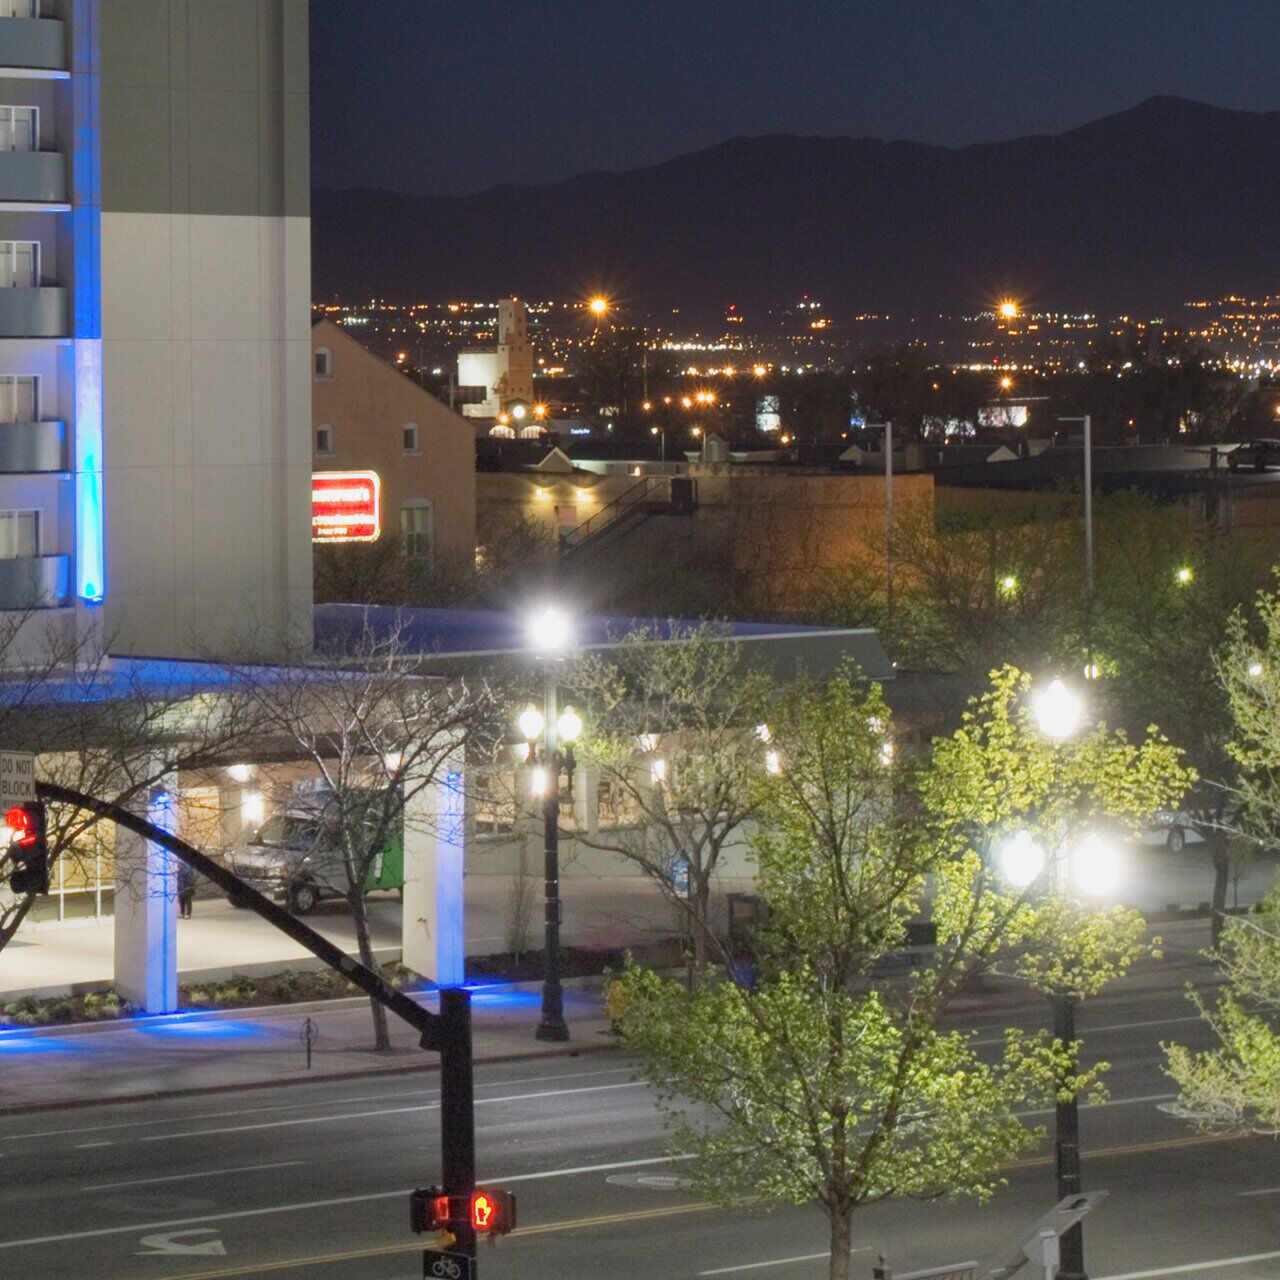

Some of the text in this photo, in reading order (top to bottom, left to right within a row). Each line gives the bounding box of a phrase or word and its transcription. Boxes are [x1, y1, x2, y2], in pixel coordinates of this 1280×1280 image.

[2, 758, 31, 775] DO NOT
[2, 780, 31, 796] BLOCK
